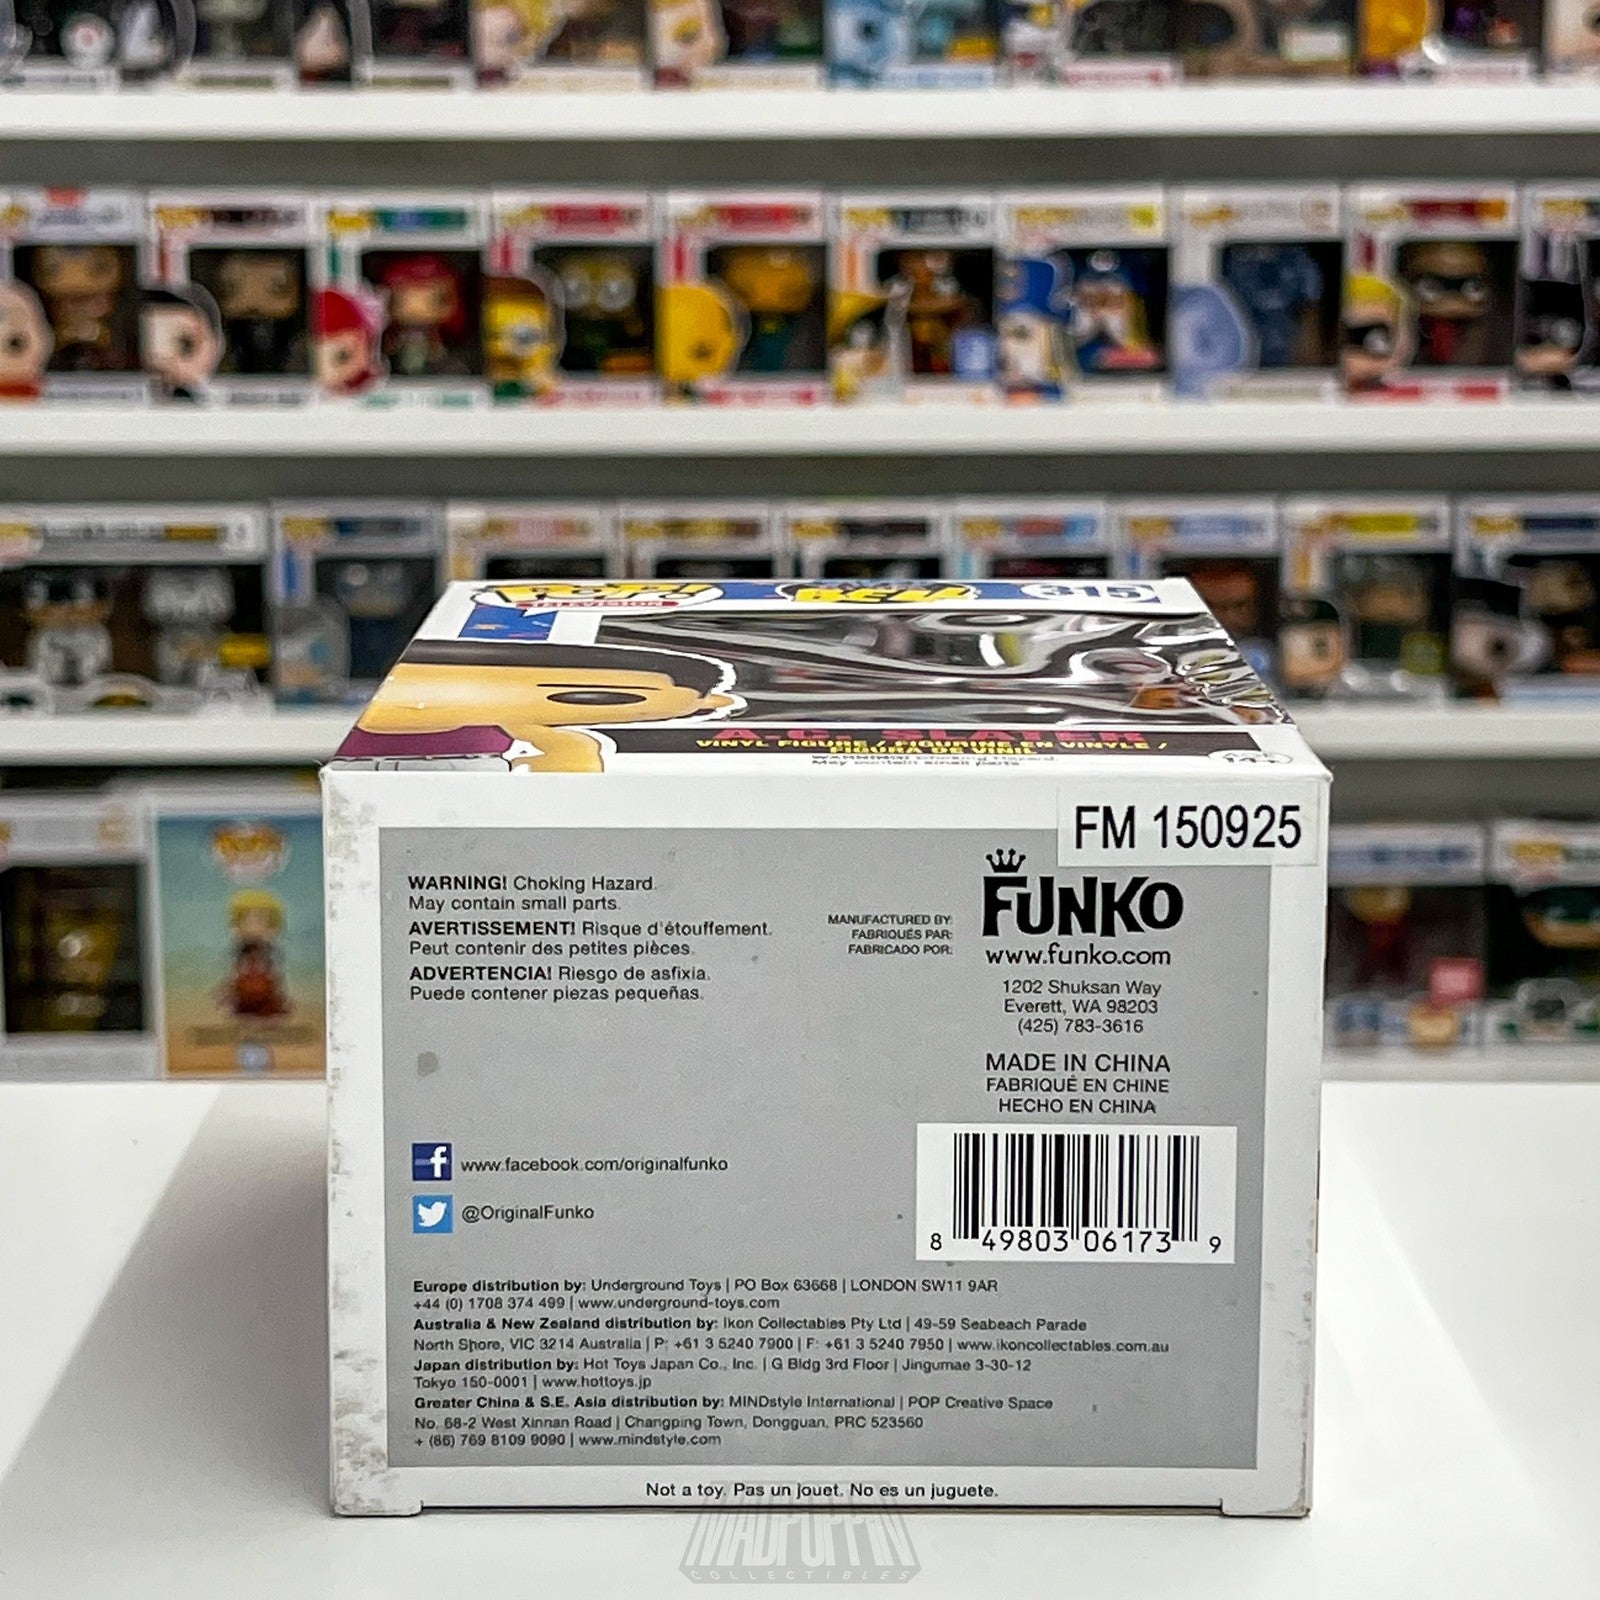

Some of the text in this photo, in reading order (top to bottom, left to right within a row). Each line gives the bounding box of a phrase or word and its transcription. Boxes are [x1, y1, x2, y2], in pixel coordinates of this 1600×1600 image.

[484, 583, 716, 603] POP!
[1039, 584, 1143, 599] 315
[712, 729, 1147, 742] A.C. SLATER
[695, 740, 868, 749] VINYL FIGURE
[1075, 804, 1302, 849] FM 150925
[407, 874, 507, 891] WARNING!
[514, 875, 585, 894] Choking
[409, 896, 445, 914] May
[451, 896, 515, 910] contain
[521, 896, 566, 910] small
[982, 872, 1184, 937] FUNKO
[828, 914, 931, 925] MANUFACTURED
[409, 920, 772, 938] AVERTISSEMENT! Risque d'étouffement.
[852, 928, 922, 940] FABRIQUÉS
[410, 939, 449, 955] Peut
[455, 941, 526, 958] contenir
[532, 941, 563, 955] des
[569, 940, 627, 958] petites
[848, 944, 920, 955] FABRICADO
[986, 943, 1171, 966] www.funko.com
[409, 966, 710, 984] ADVERTENCIA! Riesgo de asfixia.
[410, 986, 465, 1000] Puede
[471, 986, 548, 1000] contener
[553, 985, 609, 1003] piezas
[1004, 979, 1162, 997] 1202 Shuksan Way
[1005, 997, 1158, 1016] Everett, WA 98203
[1018, 1018, 1143, 1035] (425) 783-3616
[986, 1051, 1170, 1073] MADE IN CHINA
[987, 1075, 1169, 1094] FABRIQUÉ EN CHINE
[999, 1098, 1156, 1114] HECHO EN CHINA
[461, 1156, 728, 1174] www.facebook.com/originalfunko
[462, 1205, 594, 1223] @OriginalFunko
[930, 1229, 1221, 1254] 8 49803 06173 9
[413, 1278, 997, 1295] Europe distribution by: Underground Toys PO Box 63668 LONDON SW11 9AR
[414, 1296, 780, 1312] +44 (0) 1708 374 499 www.underground-toys.com
[413, 1316, 1087, 1332] Australia New Zealand distribution by: Ikon Collectables Pty Ltd 49-59 Seabeach Parade
[414, 1337, 1169, 1353] North Shore, VIC 3214 Australia 5240 7900 5240 7950 www.ikoncollectables.com.au
[414, 1357, 1031, 1374] Japan distribution by: Hot Toys Japan G Bldg 3rd Floor Jingumae 3-30-12
[414, 1375, 651, 1390] Tokyo 150-0001 www.hottoys.jp
[415, 1394, 1053, 1411] Greater China Asia distribution by: MINDstyle International POP Creative Space
[481, 1414, 516, 1429] West
[521, 1417, 569, 1429] Xinnan
[574, 1416, 612, 1428] Road
[625, 1415, 701, 1431] Changping
[835, 1416, 866, 1428] PRC
[871, 1416, 923, 1429] 523560
[579, 1433, 721, 1448] www.mindstyle.com
[646, 1483, 676, 1497] Not
[682, 1486, 692, 1497] a
[734, 1483, 766, 1497] Pas
[771, 1486, 792, 1497] un
[848, 1483, 873, 1497] No
[879, 1486, 899, 1497] es
[905, 1486, 925, 1497] un
[930, 1483, 999, 1500] juguete.
